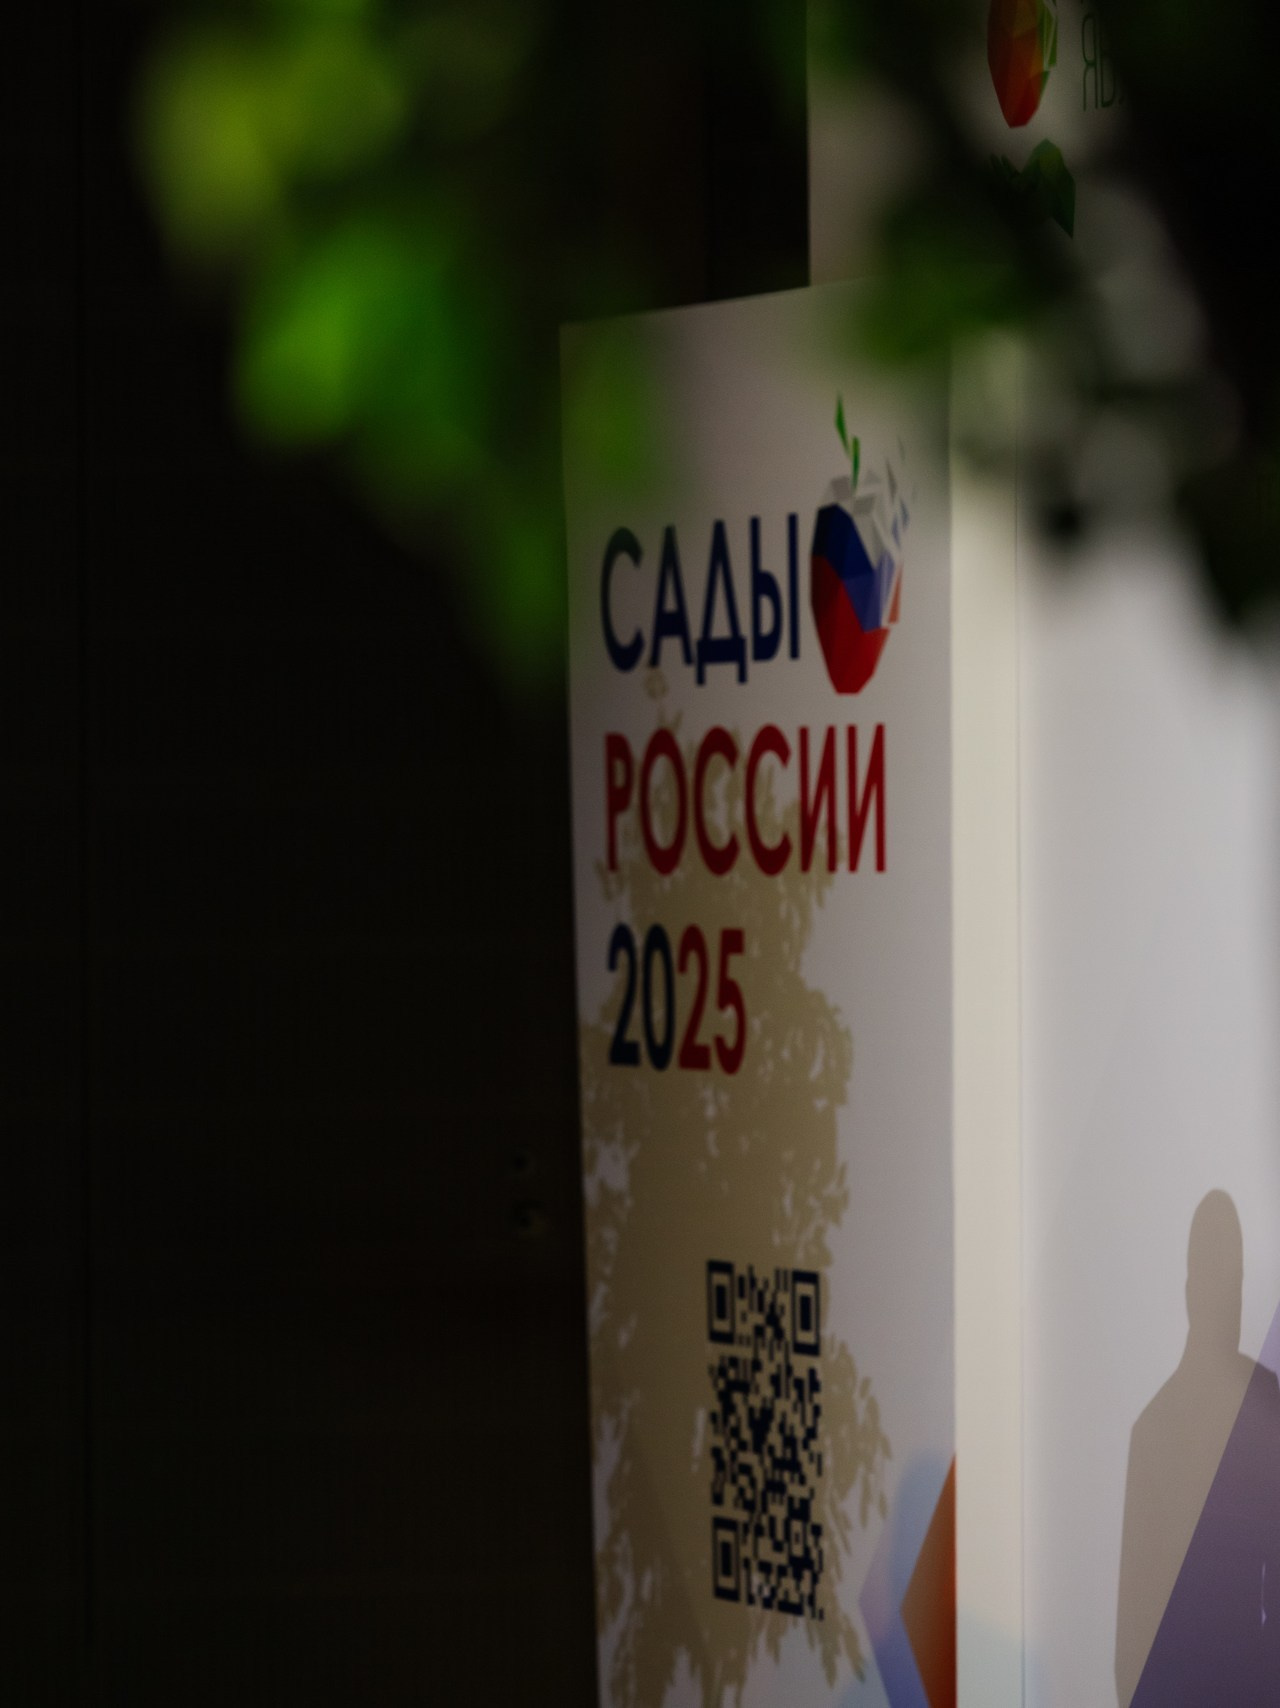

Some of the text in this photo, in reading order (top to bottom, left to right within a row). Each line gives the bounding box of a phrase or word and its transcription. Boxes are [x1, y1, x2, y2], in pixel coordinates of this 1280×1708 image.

[599, 512, 800, 686] САДЫ
[604, 722, 886, 876] РОССИИ
[607, 923, 748, 1076] 2025
